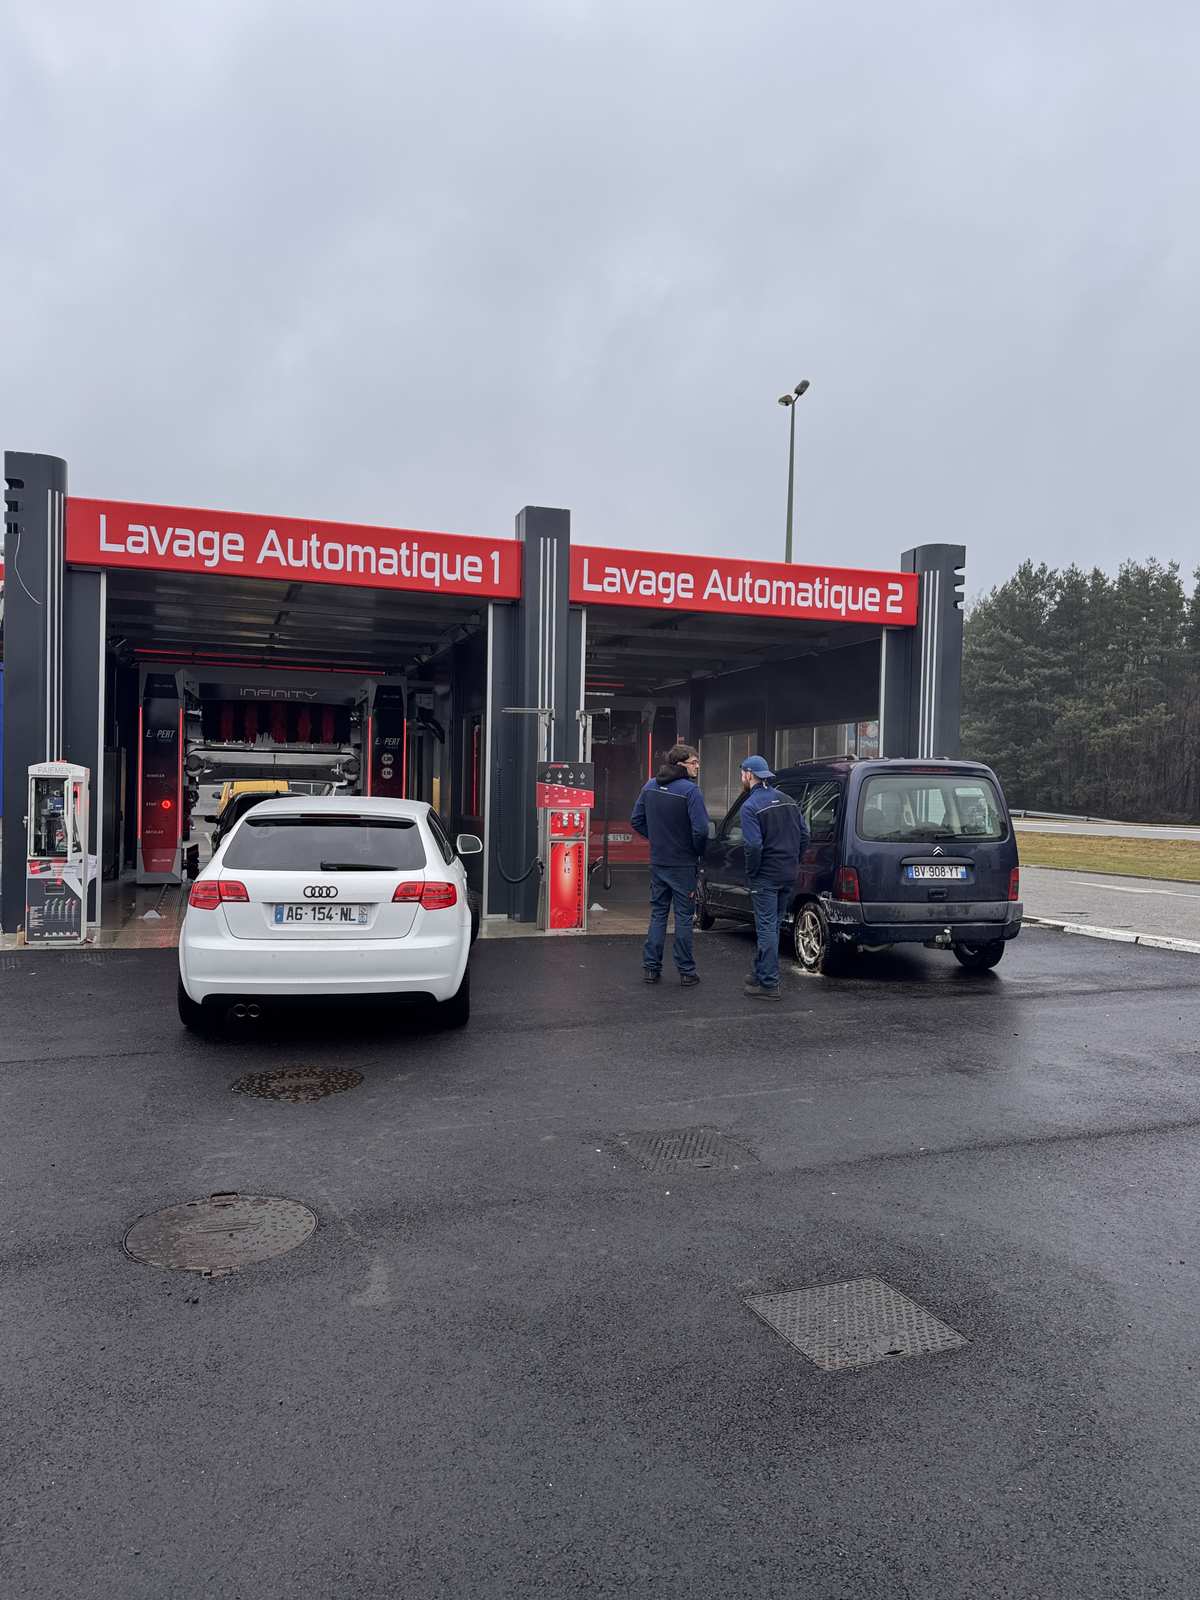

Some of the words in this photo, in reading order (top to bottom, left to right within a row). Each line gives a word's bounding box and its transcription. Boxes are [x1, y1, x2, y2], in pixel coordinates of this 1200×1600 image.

[100, 514, 245, 567] Lavage
[256, 529, 483, 587] Automatique
[491, 550, 501, 584] 1
[583, 558, 694, 603] Lavage
[703, 569, 880, 616] Automatique
[886, 583, 904, 613] 2
[240, 688, 318, 699] INFINITY
[146, 729, 175, 739] EPERT
[375, 737, 401, 746] EPERT
